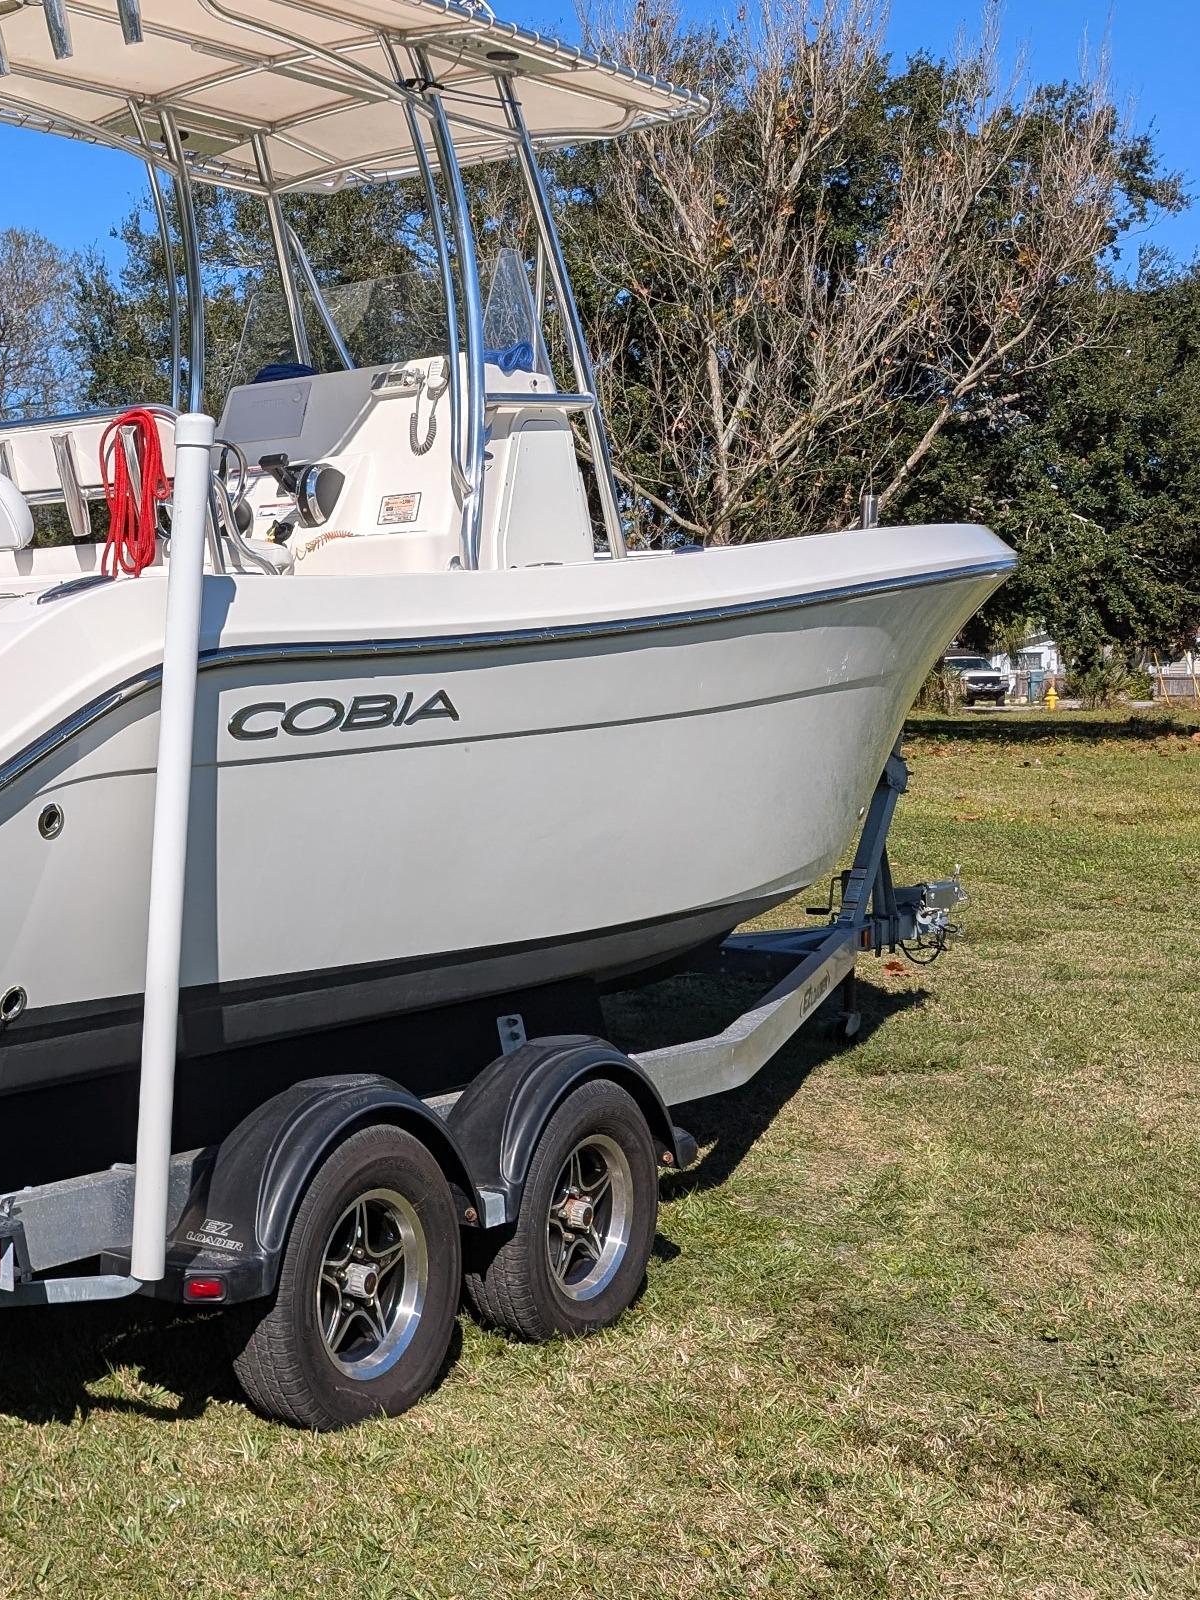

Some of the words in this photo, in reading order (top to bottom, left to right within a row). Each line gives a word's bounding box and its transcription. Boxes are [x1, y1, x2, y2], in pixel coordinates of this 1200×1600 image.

[228, 689, 459, 741] COBIA
[200, 1218, 233, 1236] EZ
[186, 1232, 243, 1251] LOADER
